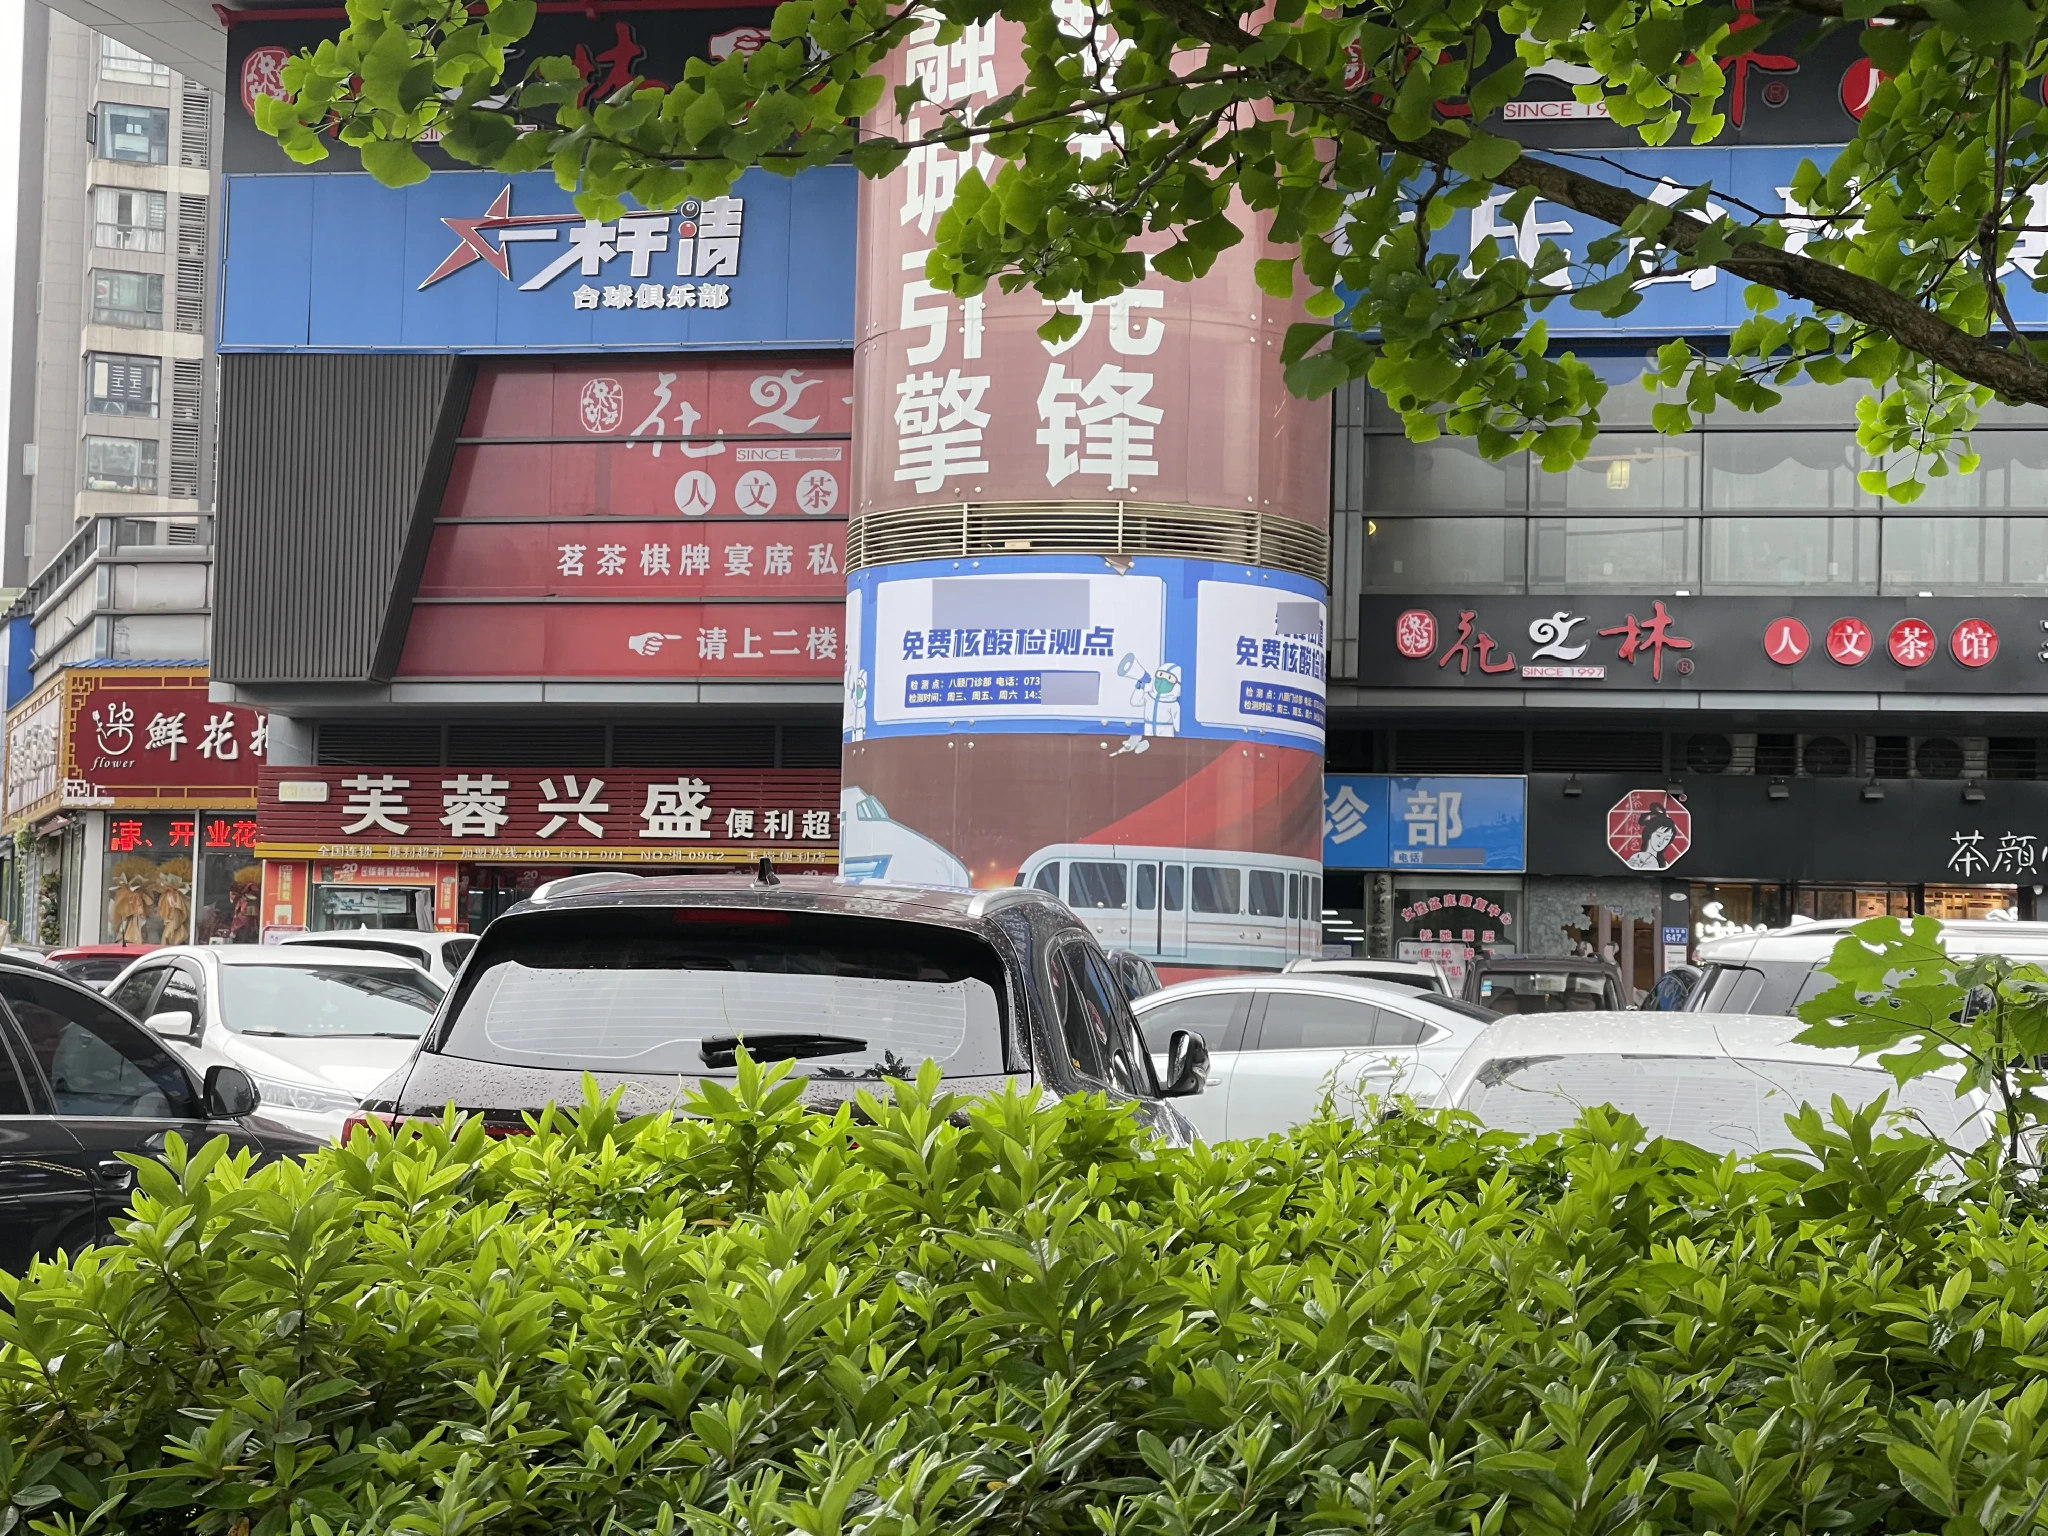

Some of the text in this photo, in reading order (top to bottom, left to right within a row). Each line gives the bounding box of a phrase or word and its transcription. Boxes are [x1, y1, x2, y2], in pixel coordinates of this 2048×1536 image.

[1505, 103, 1572, 118] SINCE
[573, 284, 731, 309] 台球俱乐部
[625, 368, 854, 459] 花之
[737, 449, 790, 461] SINCE
[679, 474, 839, 511] 人文茶
[556, 542, 848, 577] 茗茶棋牌宴席私
[696, 627, 837, 661] 请上二楼
[902, 625, 1115, 660] 免费核酸检测点
[1236, 634, 1326, 683] 免费核酸检
[1772, 623, 1992, 662] 人文茶馆
[1524, 666, 1605, 678] SINCE 1997
[90, 757, 136, 772] flower
[340, 774, 840, 841] 芙蓉兴盛 便利超
[317, 845, 373, 858] 全国连锁
[387, 846, 445, 859] 便利超市
[1401, 893, 1513, 926] 女性盆底康复中心
